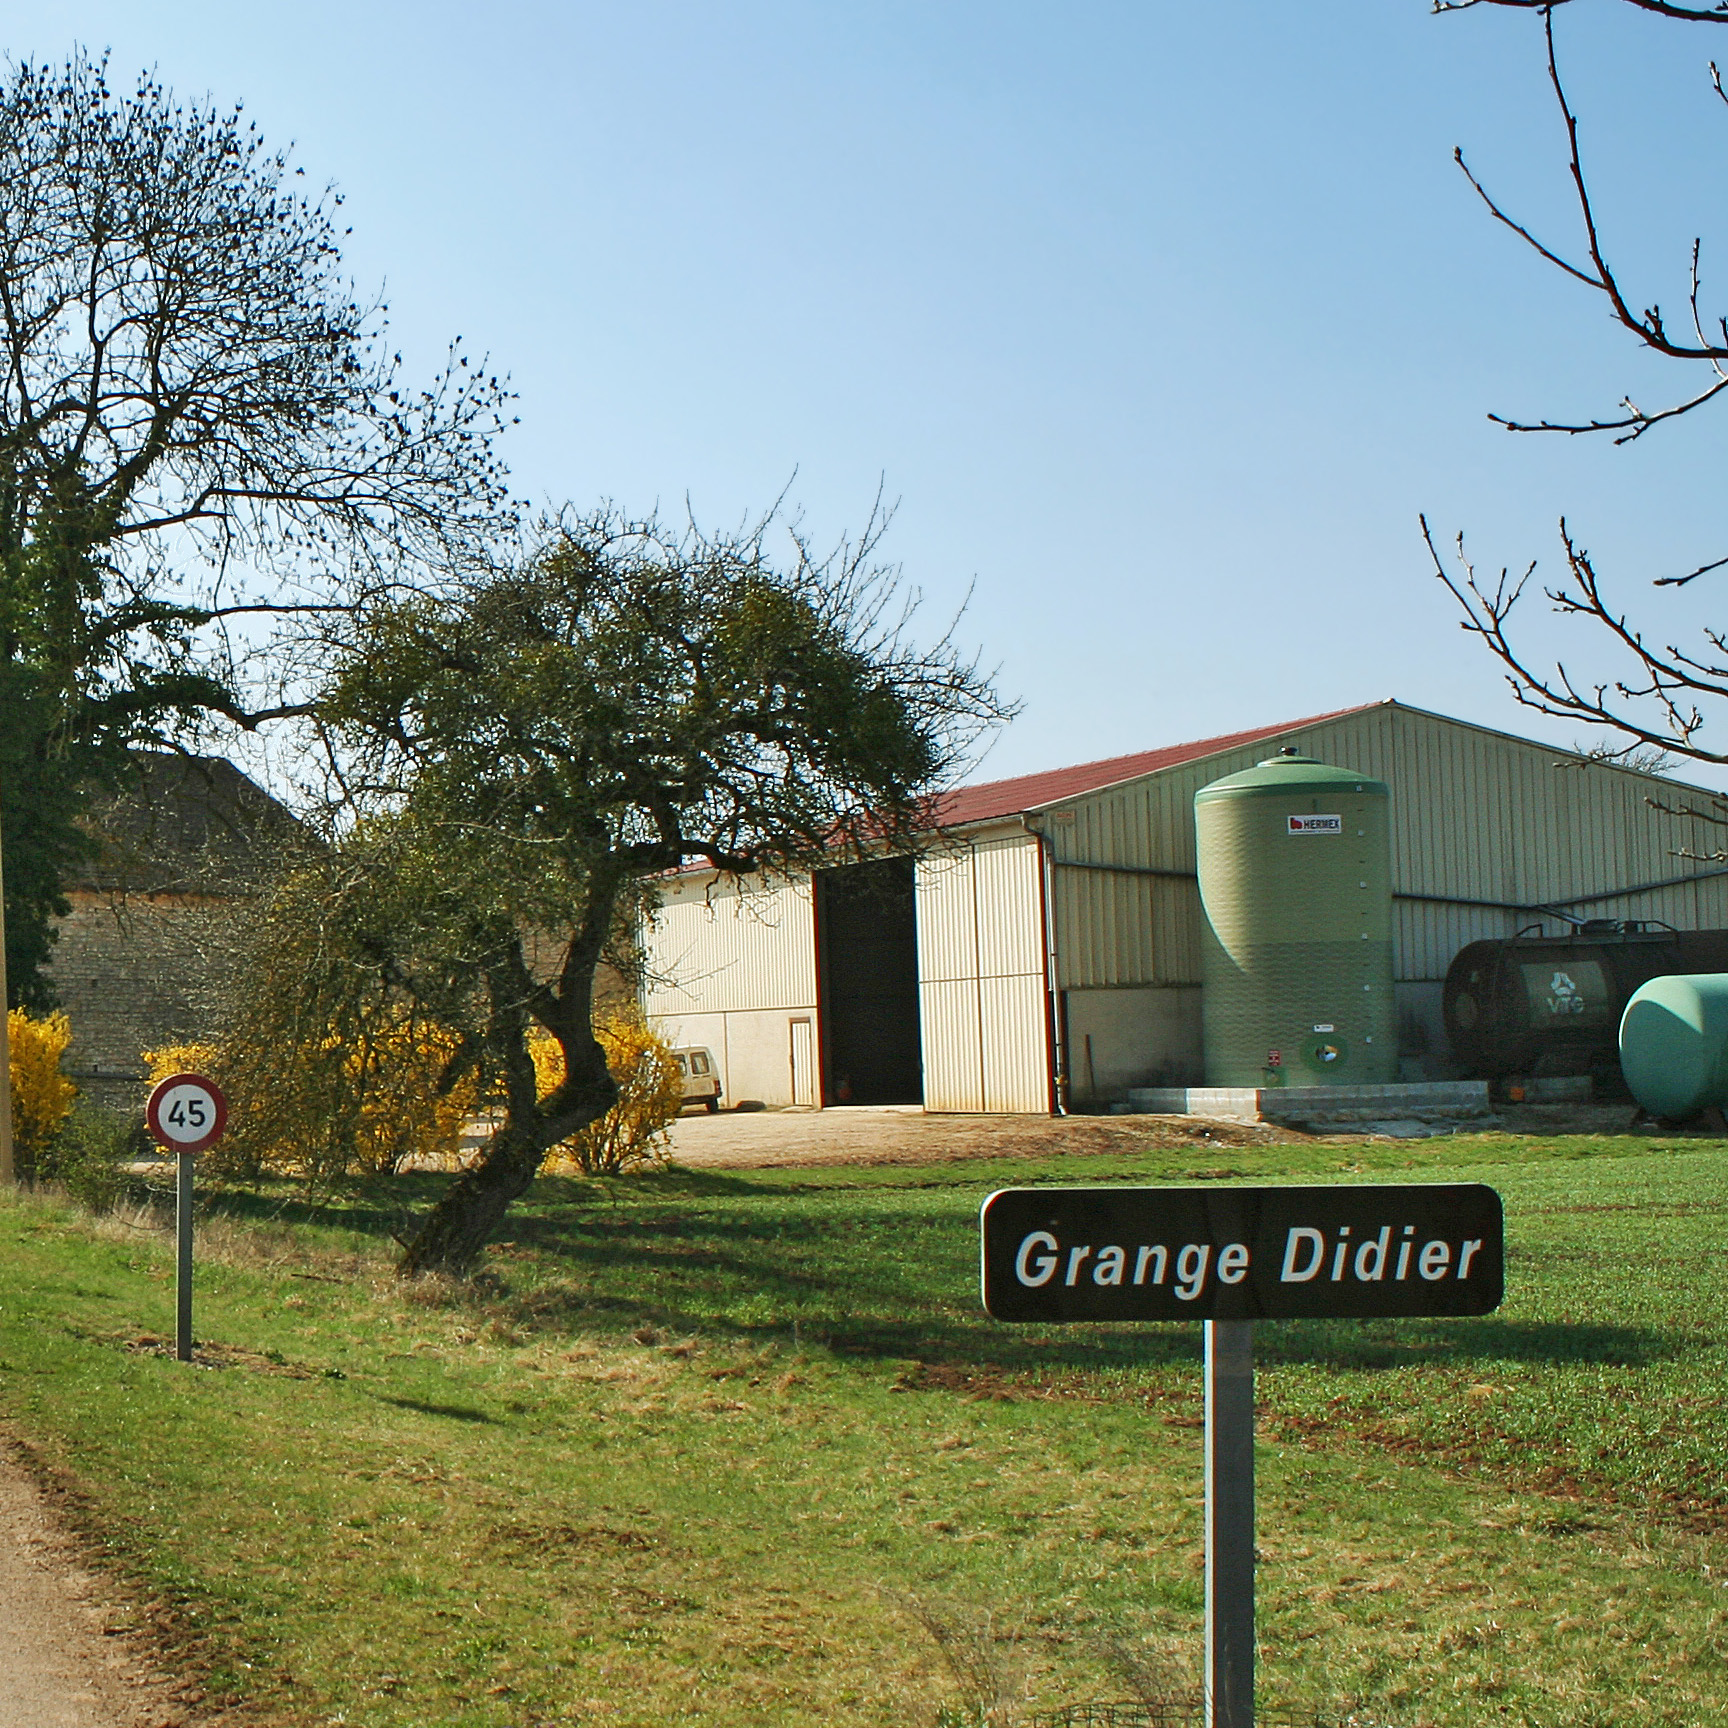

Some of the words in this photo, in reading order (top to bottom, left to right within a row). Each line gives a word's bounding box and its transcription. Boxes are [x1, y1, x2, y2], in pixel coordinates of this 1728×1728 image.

[168, 1100, 206, 1127] 45
[1015, 1231, 1249, 1300] Grange
[1280, 1225, 1482, 1283] Didier
